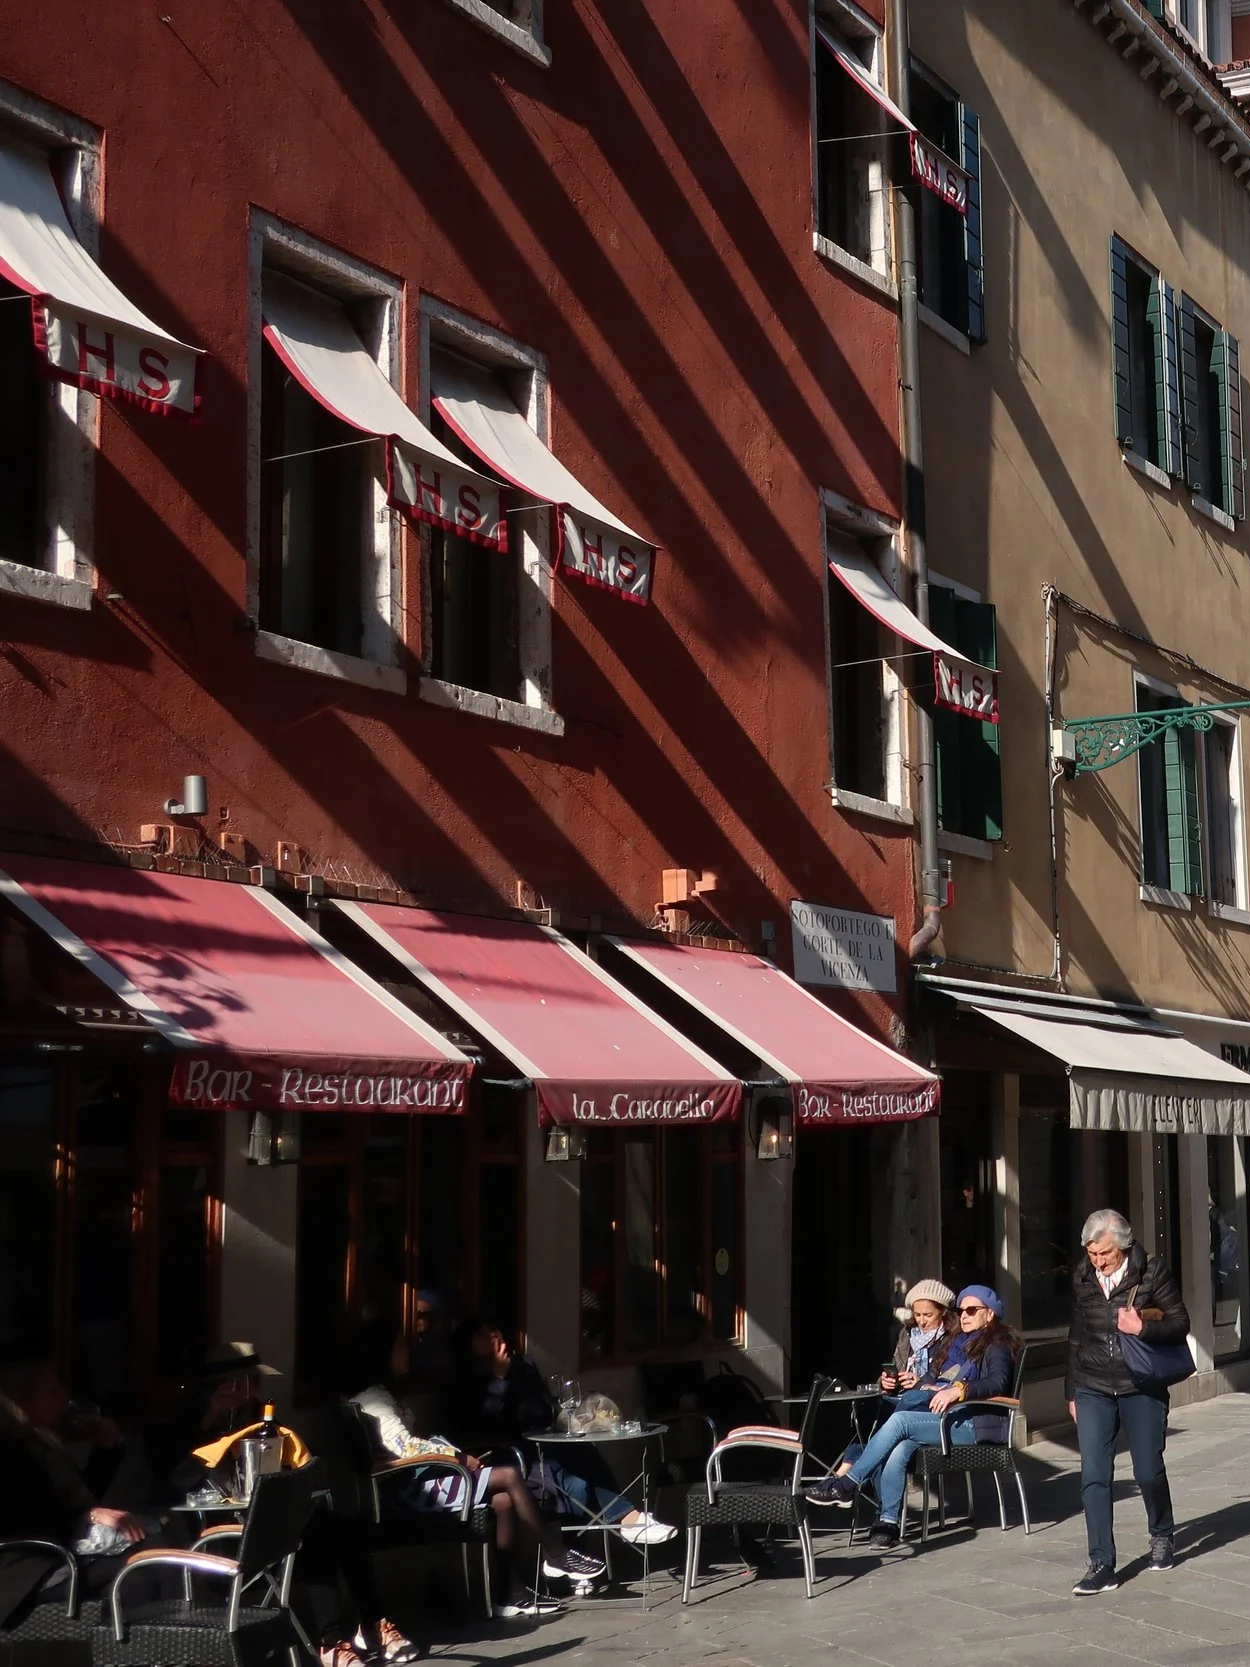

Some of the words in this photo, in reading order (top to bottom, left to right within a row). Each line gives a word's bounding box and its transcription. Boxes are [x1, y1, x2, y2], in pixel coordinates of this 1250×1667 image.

[791, 909, 881, 938] SOTOPORTEGO
[885, 923, 894, 941] E
[803, 934, 842, 956] CORTE
[848, 940, 864, 959] DE
[868, 943, 884, 962] LA
[820, 959, 869, 983] VICENZA
